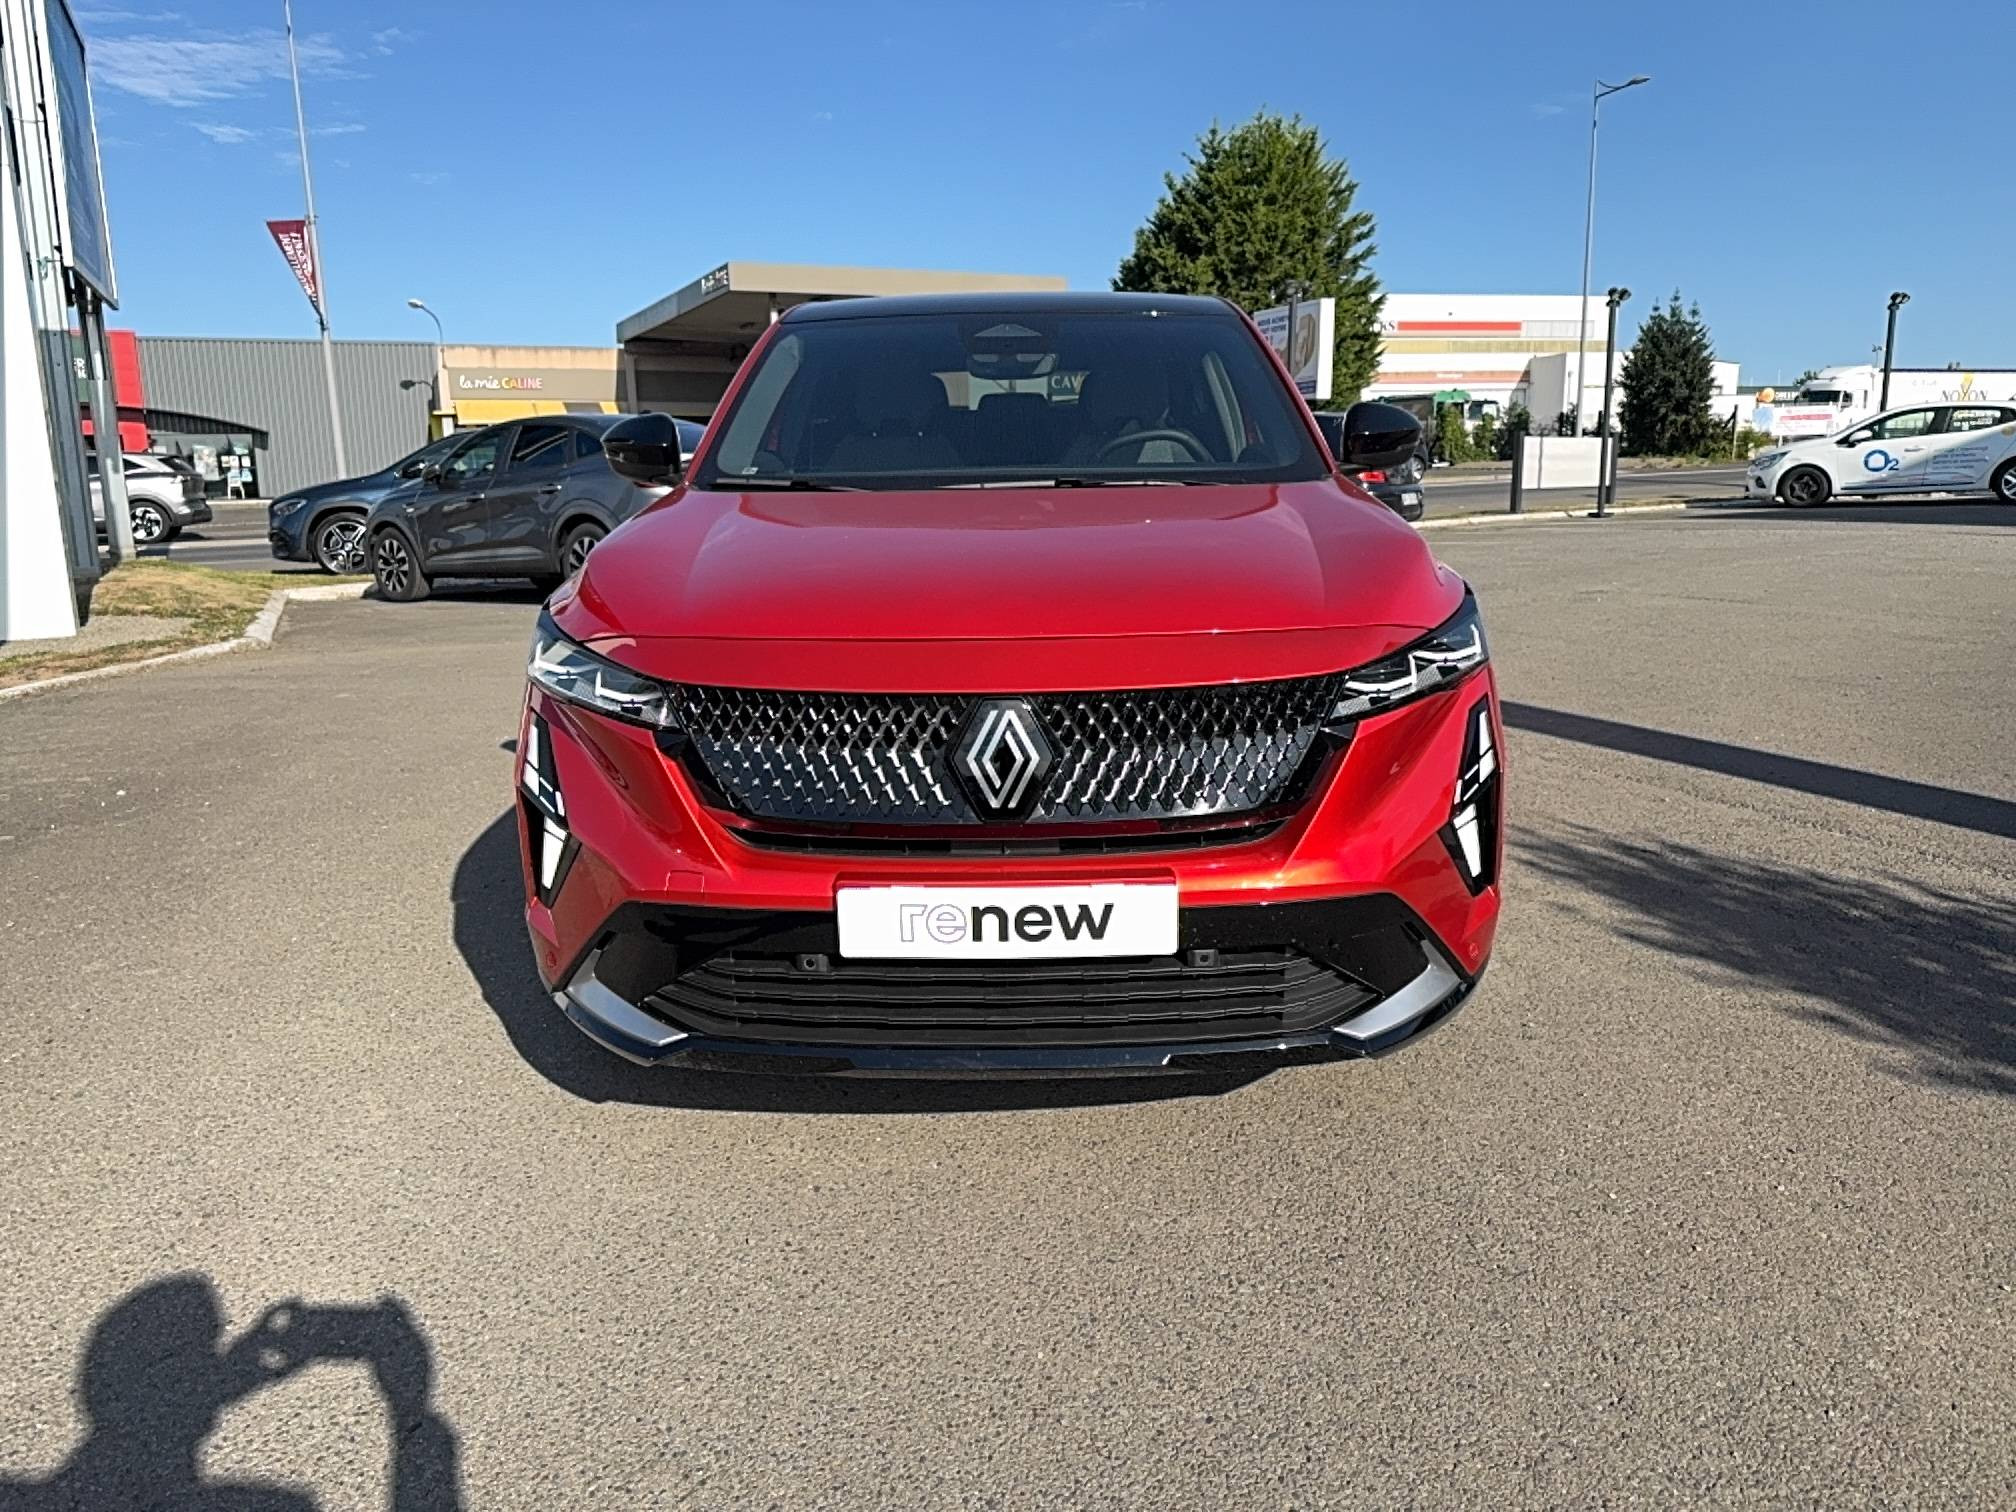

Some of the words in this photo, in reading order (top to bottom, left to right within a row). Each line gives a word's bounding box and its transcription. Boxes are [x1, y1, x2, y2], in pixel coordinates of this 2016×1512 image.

[459, 374, 473, 389] la
[474, 375, 500, 389] mie
[899, 903, 1114, 944] renew
